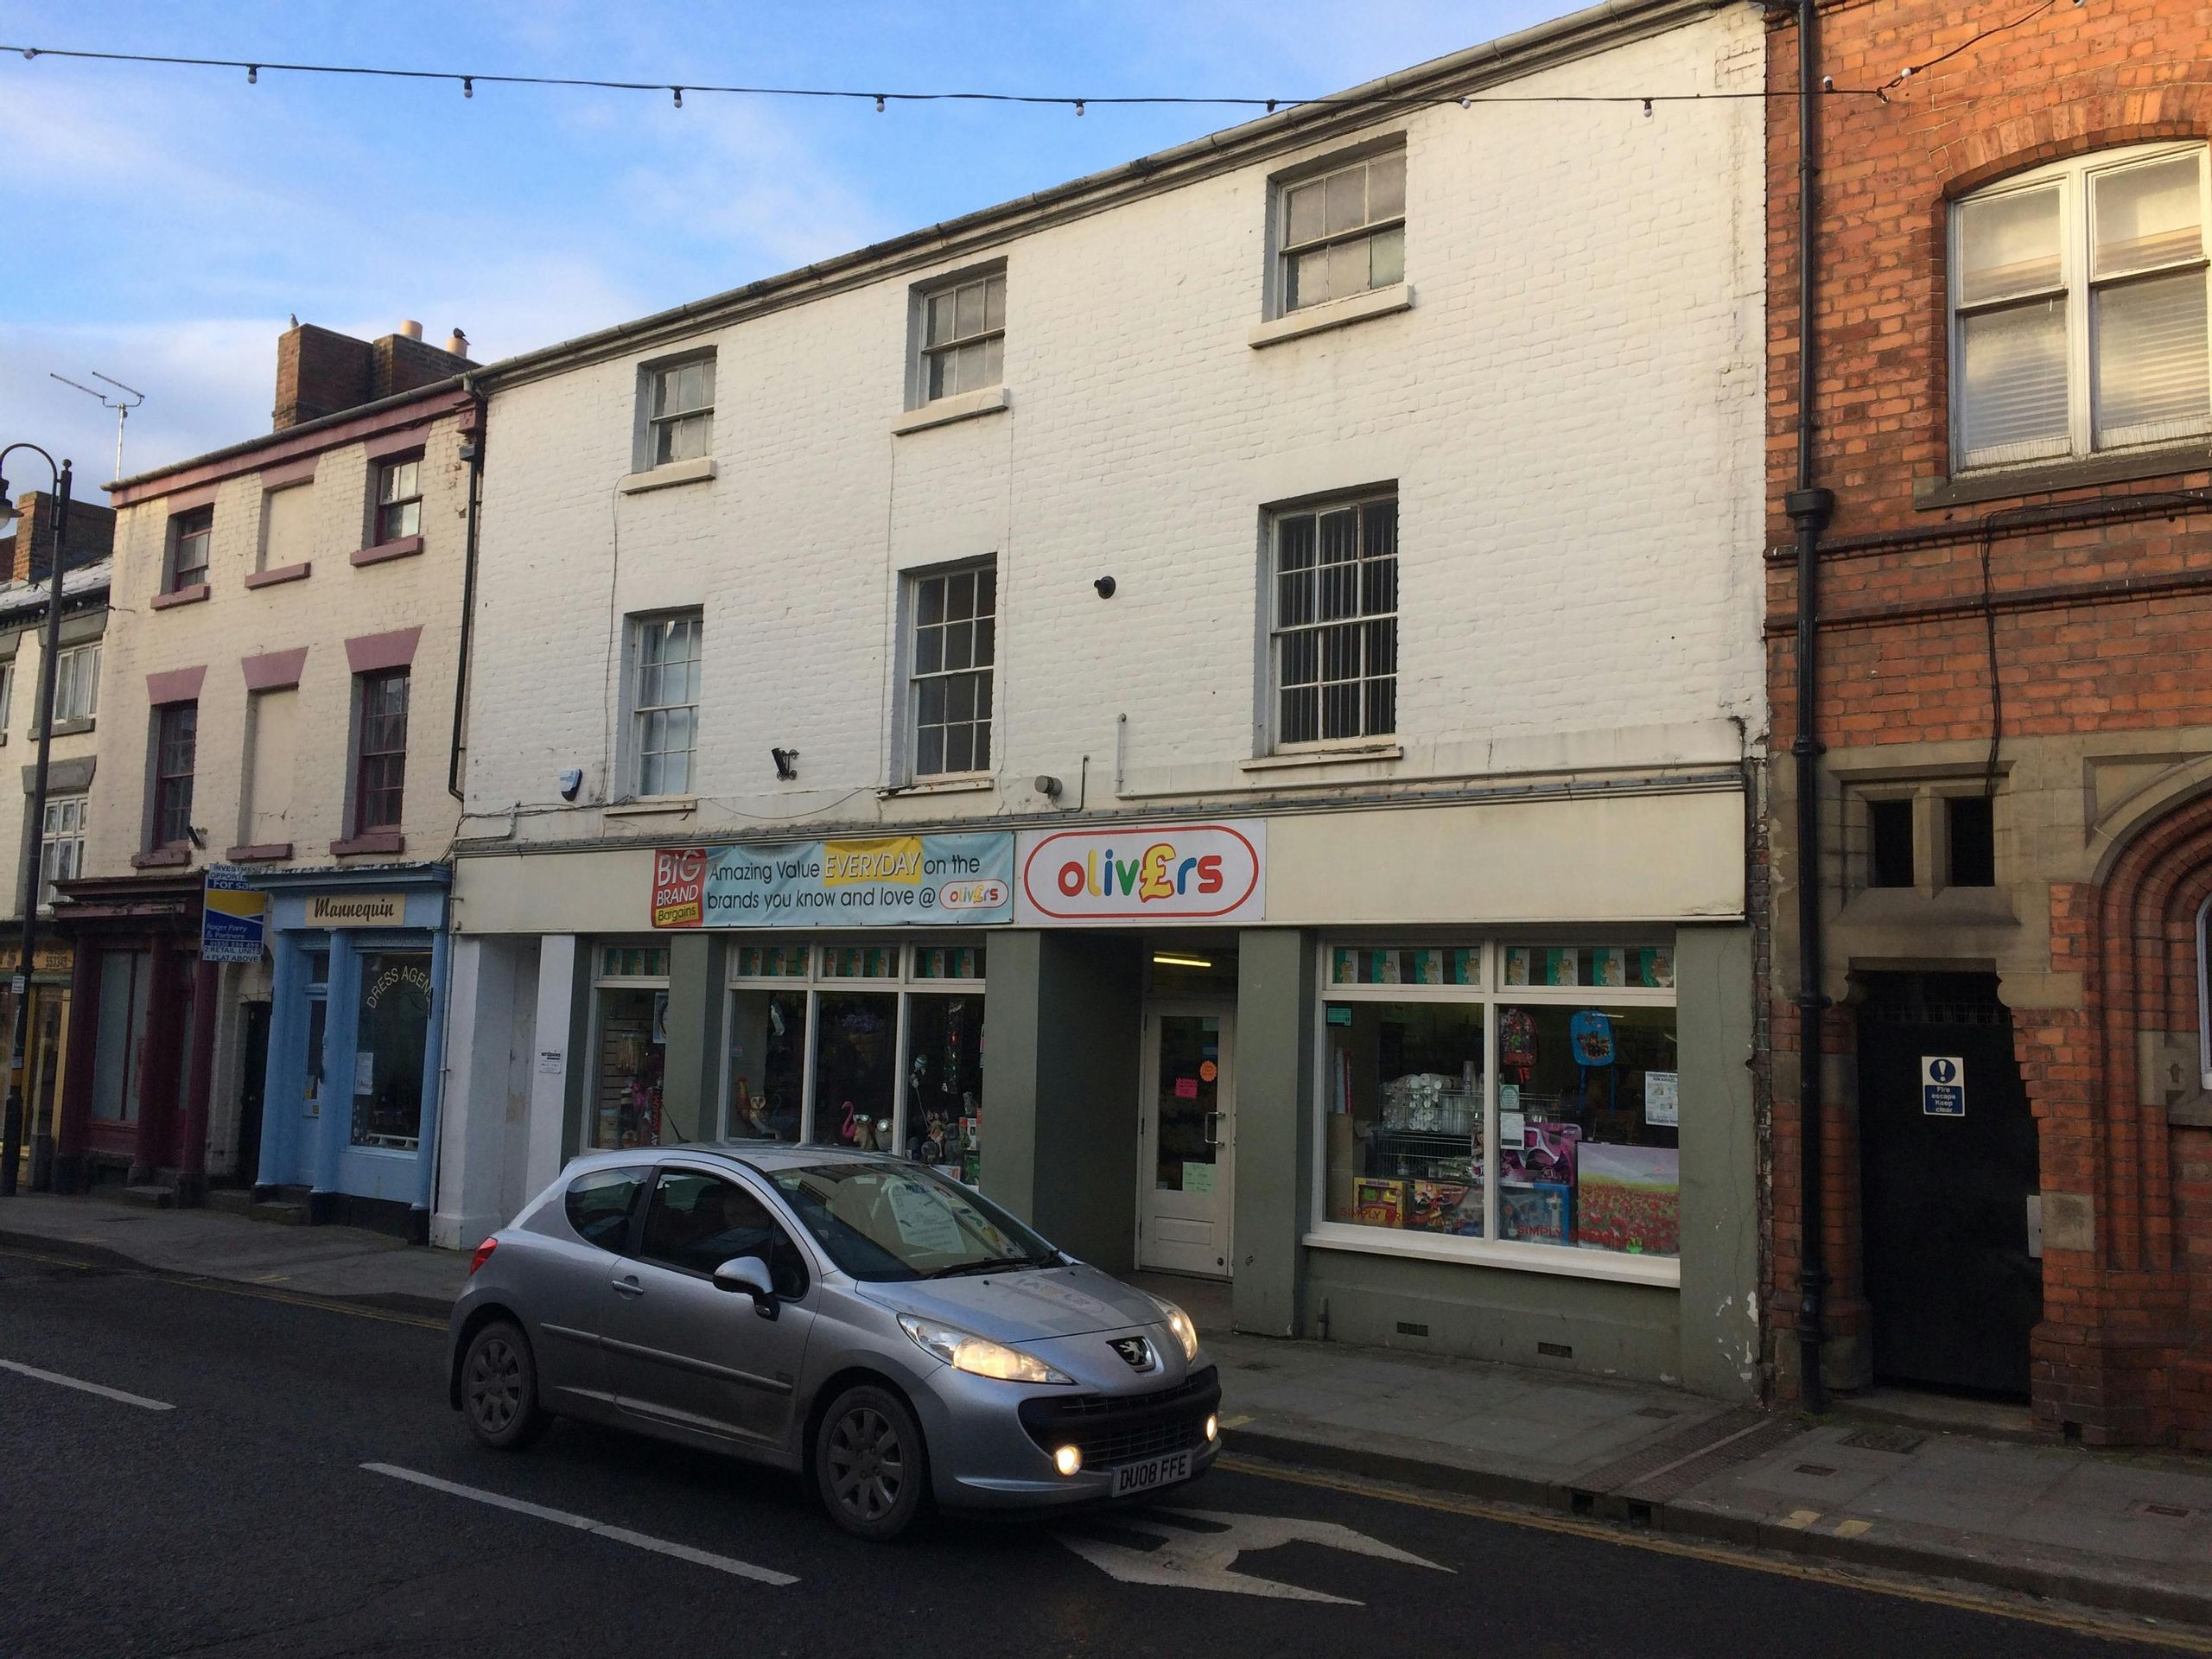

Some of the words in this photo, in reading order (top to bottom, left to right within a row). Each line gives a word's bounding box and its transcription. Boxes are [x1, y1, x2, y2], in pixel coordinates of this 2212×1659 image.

[709, 862, 772, 884] Amazing
[776, 860, 820, 879] Value
[825, 851, 921, 878] EVERYDAY
[924, 858, 946, 874] on
[951, 854, 980, 874] the
[213, 880, 233, 889] For
[236, 881, 260, 891] sa
[656, 884, 699, 907] BRAND
[314, 898, 395, 922] Mannequin
[707, 891, 760, 909] brands
[764, 893, 791, 912] you
[796, 888, 836, 907] know
[841, 887, 875, 906] and
[880, 886, 914, 906] love
[918, 887, 936, 908] @
[658, 906, 696, 922] Bargains
[366, 967, 398, 1009] DRESS
[400, 965, 432, 1000] AGEN
[1119, 1462, 1157, 1491] DU08
[1160, 1454, 1187, 1483] FFE
